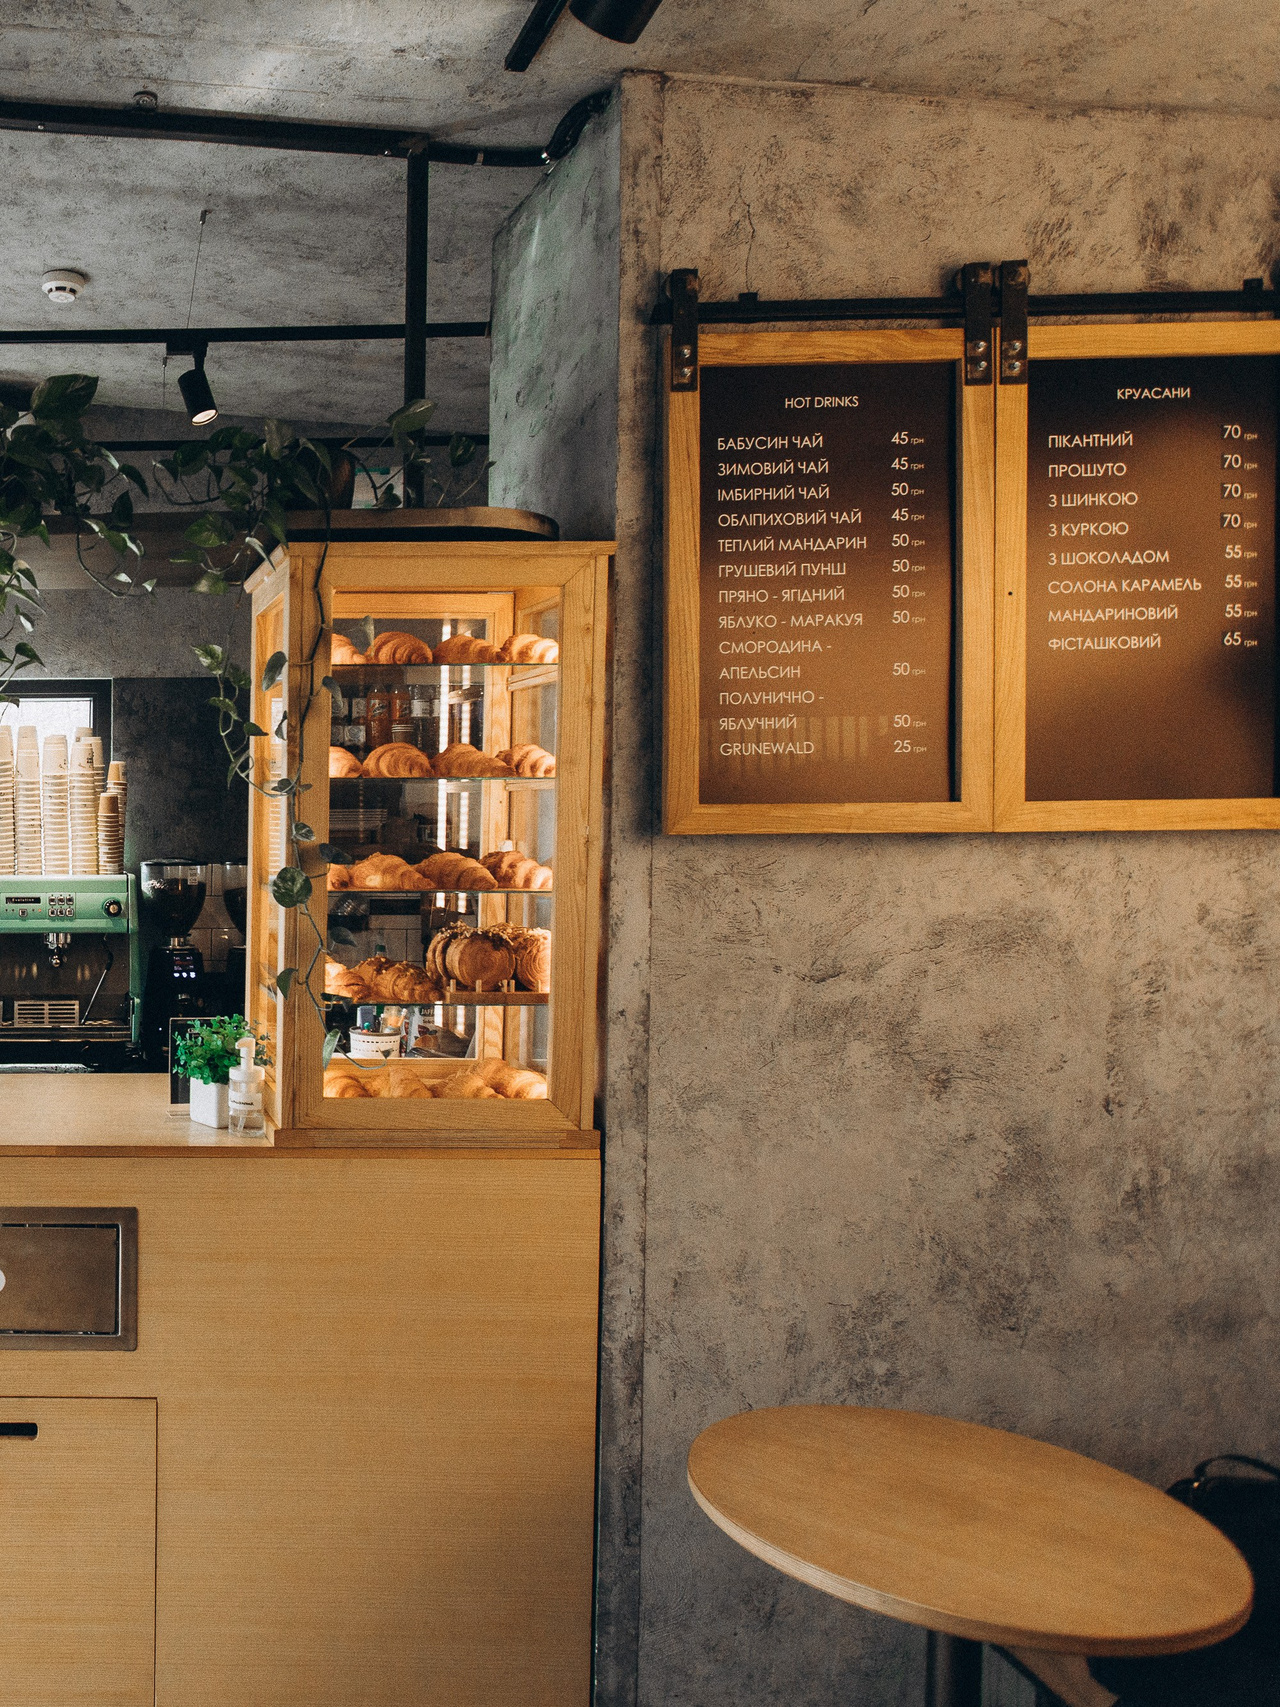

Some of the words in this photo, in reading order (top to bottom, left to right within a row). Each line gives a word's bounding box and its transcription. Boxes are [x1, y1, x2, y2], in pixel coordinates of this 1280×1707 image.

[785, 397, 811, 408] HOT
[815, 396, 859, 407] DRINKS
[1117, 387, 1190, 399] КРУАСАНИ
[718, 436, 788, 450] БАБУСИН
[792, 433, 823, 448] ЧАЙ
[892, 432, 908, 444] 45
[1049, 431, 1133, 447] ПІКАНТНИЙ
[1224, 424, 1241, 438] 70
[718, 459, 794, 476] ЗИМОВИЙ
[798, 459, 829, 473] ЧАЙ
[891, 457, 908, 470] 45
[1049, 463, 1127, 477] ПРОШУТО
[1225, 454, 1241, 468] 70
[718, 485, 794, 501] ІМБИРНИЙ
[799, 484, 829, 499] ЧАЙ
[892, 483, 909, 496] 50
[1062, 492, 1139, 506] ШИНКОЮ
[1225, 483, 1241, 497] 70
[718, 510, 826, 526] ОБЛІПИХОВИЙ
[831, 509, 861, 523] ЧАЙ
[892, 508, 909, 521] 45
[1062, 522, 1129, 536] КУРКОЮ
[1224, 514, 1241, 527] 70
[718, 537, 774, 552] ТЕПЛИЙ
[779, 537, 867, 551] МАНДАРИН
[892, 534, 909, 546] 50
[1062, 550, 1169, 564] ШОКОЛАДОМ
[1225, 545, 1242, 558] 55
[719, 562, 796, 577] ГРУШЕВИЙ
[801, 563, 846, 576] ПУНШ
[892, 559, 909, 572] 50
[1049, 580, 1118, 593] СОЛОНА
[1123, 578, 1202, 591] КАРАМЕЛЬ
[1225, 574, 1242, 588] 55
[719, 590, 768, 603] ПРЯНО
[782, 586, 844, 602] ЯГІДНИЙ
[892, 585, 910, 598] 50
[719, 615, 777, 628] ЯБЛУКО
[791, 613, 863, 626] МАРАКУЯ
[892, 610, 910, 623] 50
[1049, 604, 1178, 622] МАНДАРИНОВИЙ
[1225, 604, 1242, 617] 55
[719, 640, 822, 654] СМОРОДИНА
[1049, 633, 1161, 650] ФІСТАШКОВИЙ
[1224, 632, 1241, 645] 65
[719, 666, 800, 679] АПЕЛЬСИН
[893, 662, 910, 675] 50
[720, 691, 814, 704] ПОЛУНИЧНО
[720, 714, 797, 730] ЯБЛУЧНИЙ
[894, 715, 911, 727] 50
[720, 742, 814, 756] GRUNEWALD
[894, 740, 911, 752] 25
